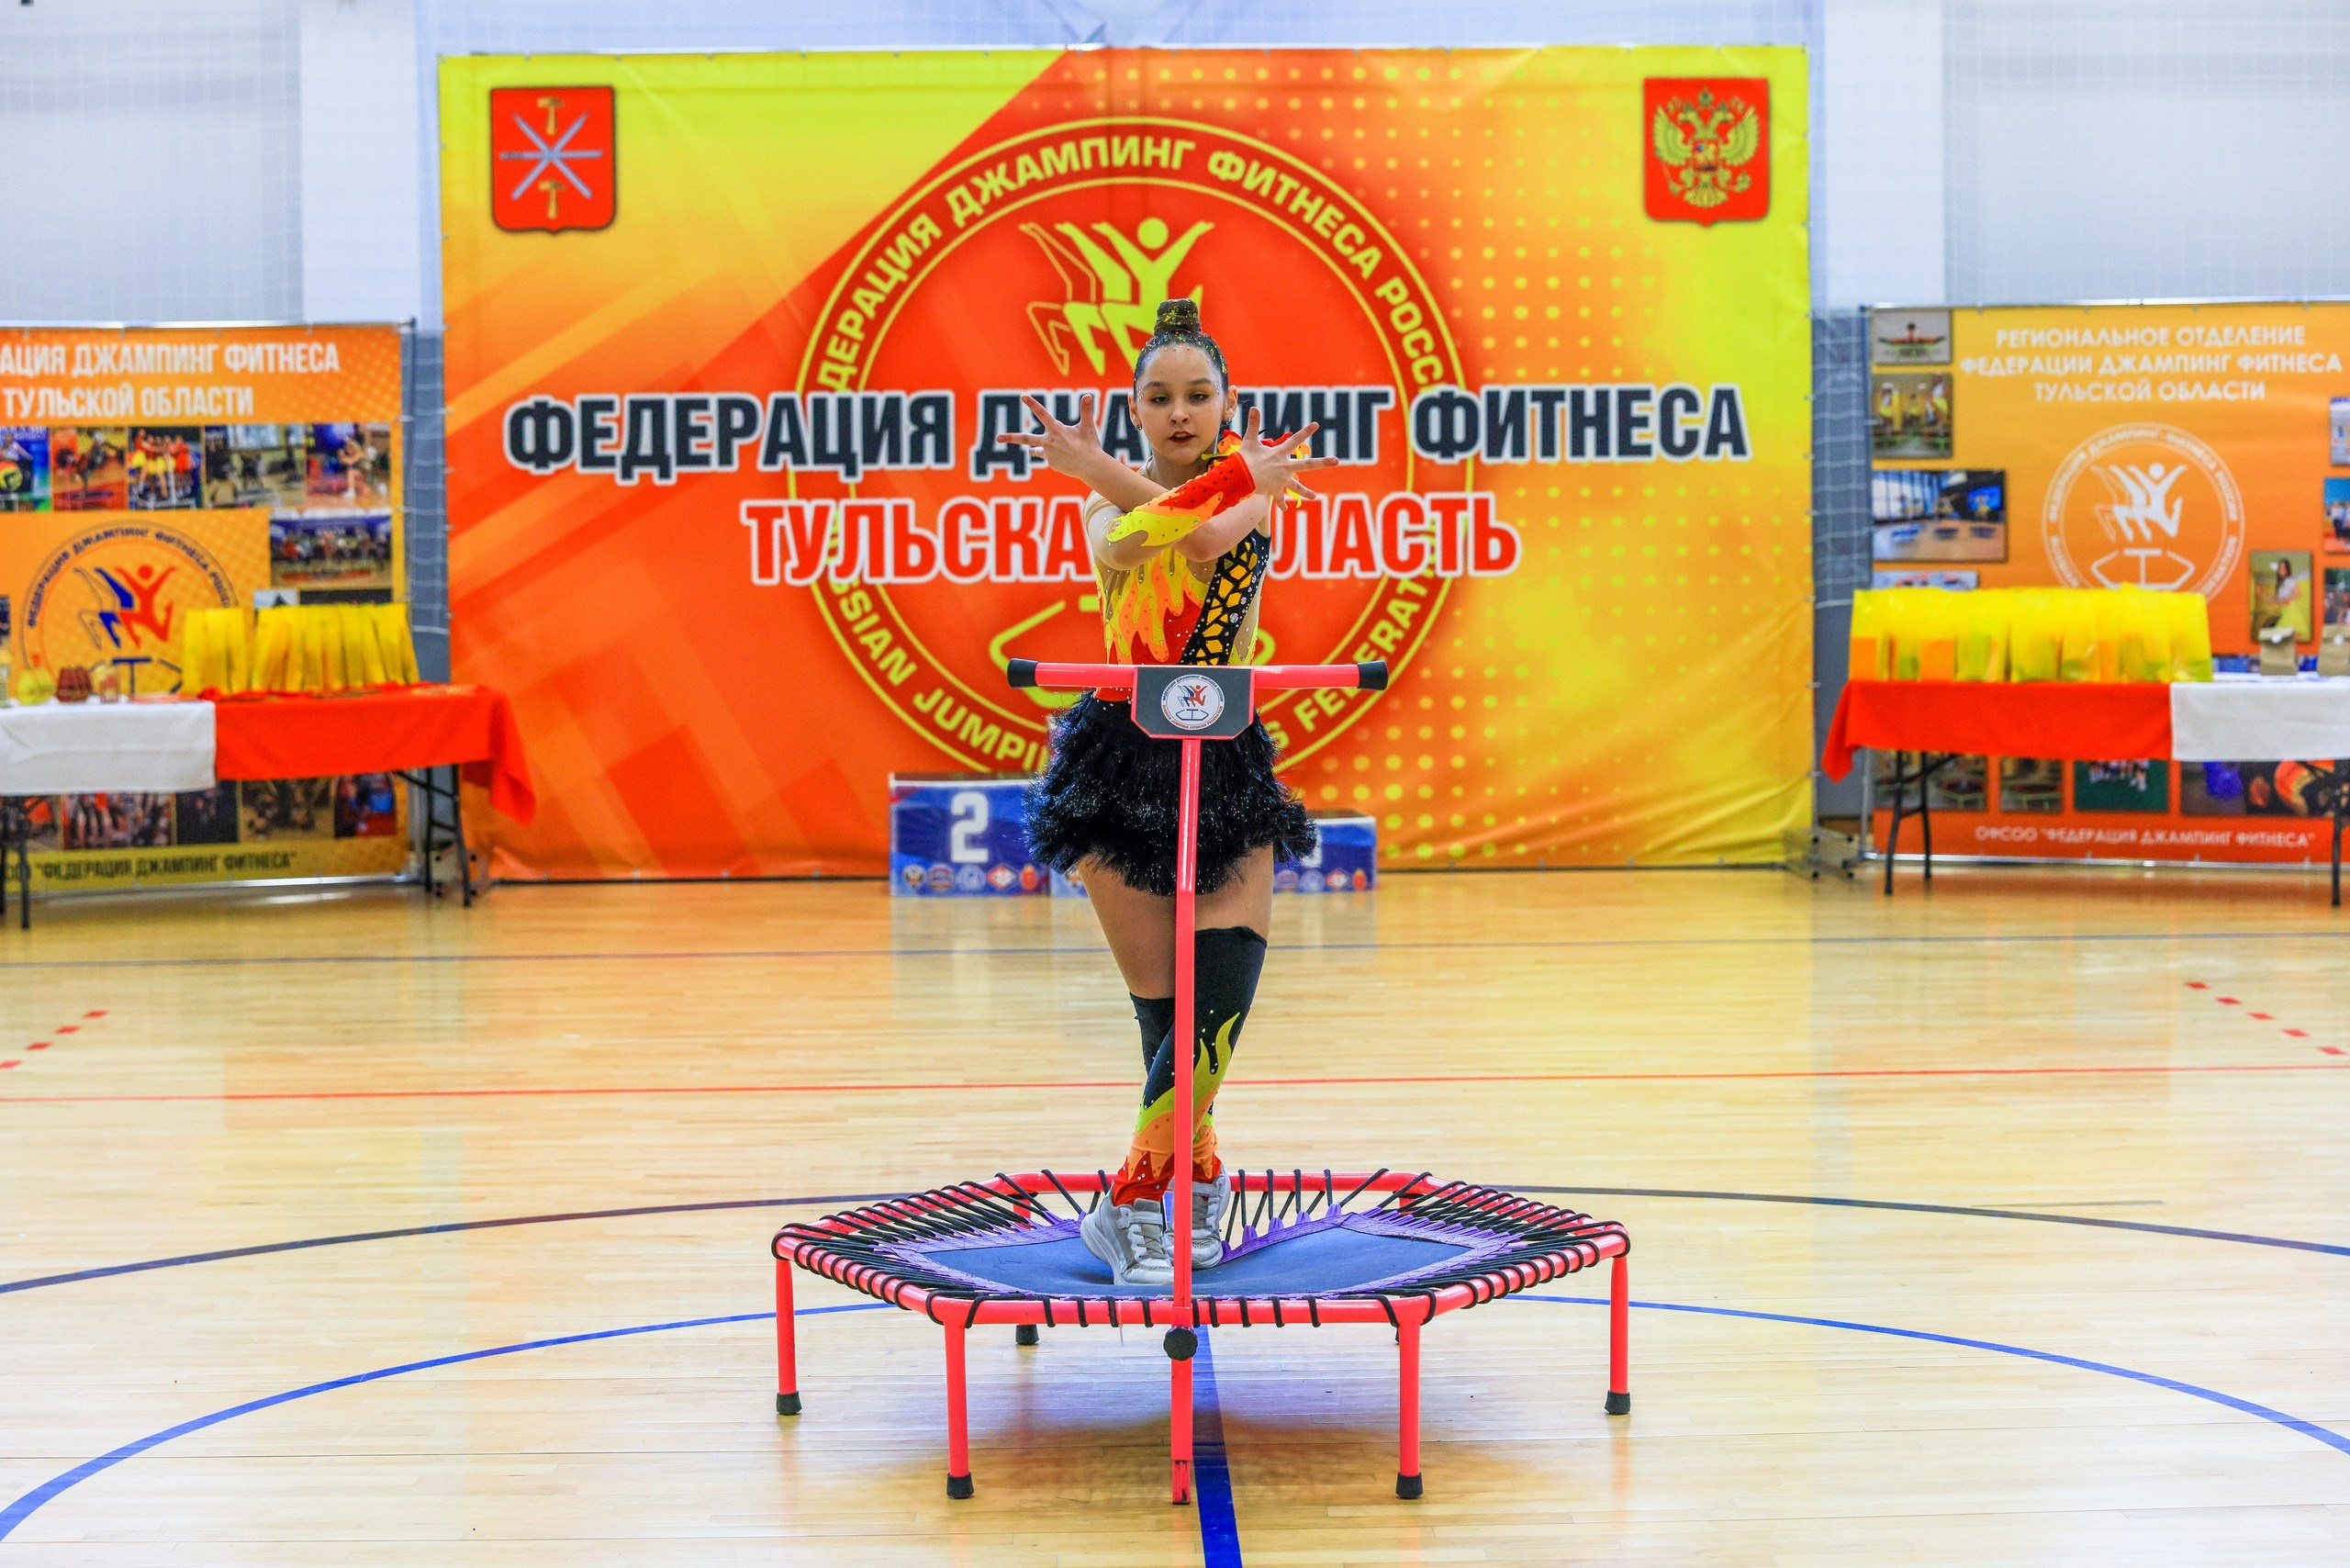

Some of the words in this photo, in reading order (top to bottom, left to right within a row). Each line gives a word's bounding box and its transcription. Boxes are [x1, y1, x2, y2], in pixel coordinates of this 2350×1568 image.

[817, 213, 943, 393] ДЕРАЦИЯ
[945, 135, 1196, 229] ДЖАМПИНГ
[1207, 151, 1383, 280] ФИТНЕСА
[1374, 275, 1447, 395] РОСС
[72, 343, 219, 376] ДЖАМПИНГ
[224, 342, 341, 374] ФИТНЕСА
[1996, 327, 2169, 348] РЕГИОНАЛЬНОЕ
[2176, 325, 2306, 348] ОТДЕЛЕНИЕ
[1959, 355, 2093, 377] ФЕДЕРАЦИИ
[2098, 353, 2234, 375] ДЖАМПИНГ
[2236, 353, 2343, 375] ФИТНЕСА
[2034, 377, 2152, 401] ТУЛЬСКОЙ
[2158, 379, 2266, 401] ОБЛАСТИ
[3, 383, 135, 419] ТУЛЬСКОЙ
[140, 386, 253, 419] ОБЛАСТИ
[505, 392, 953, 483] ФЕДЕРАЦИЯ
[1412, 384, 1751, 463] ФИТНЕСА
[741, 496, 1096, 585] ТУЛЬСКА
[1269, 492, 1521, 580] ЛАСТЬ
[912, 688, 1049, 774] JUMPI
[950, 790, 990, 864] 2
